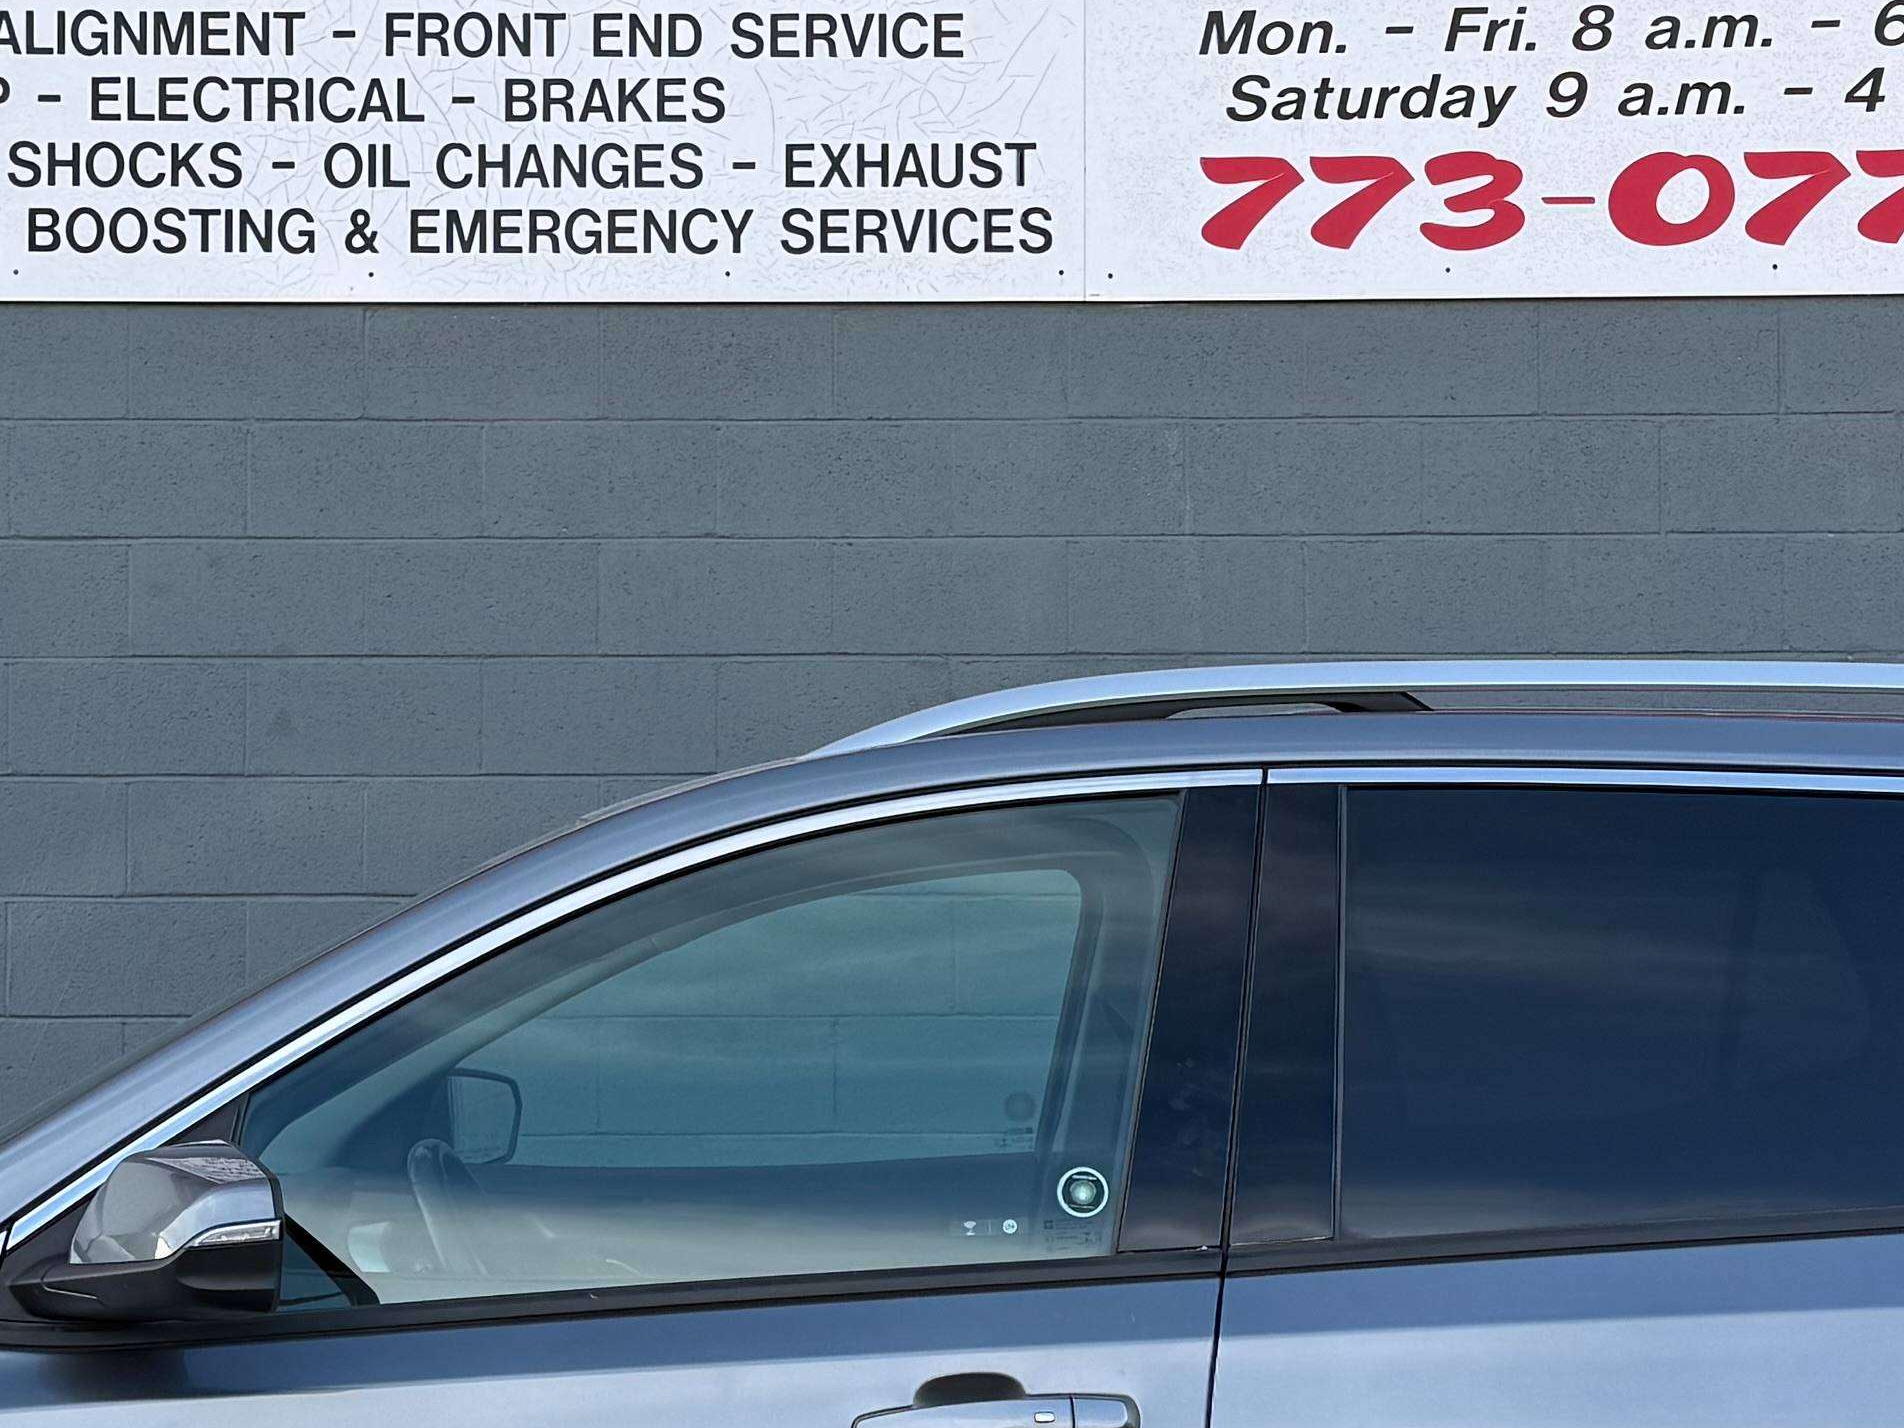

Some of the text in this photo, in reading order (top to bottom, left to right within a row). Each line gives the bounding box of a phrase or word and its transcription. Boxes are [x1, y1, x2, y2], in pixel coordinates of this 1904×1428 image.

[386, 12, 566, 57] FRONT
[594, 13, 702, 57] END
[731, 12, 963, 59] SERVICE
[1199, 10, 1346, 55] Mon.
[1445, 7, 1536, 51] Fri.
[1572, 5, 1614, 51] 8
[1645, 15, 1772, 49] a.m.
[92, 76, 424, 123] ELECTRICAL
[505, 77, 725, 123] BRAKES
[1227, 74, 1516, 128] Saturday
[1547, 72, 1587, 117] 9
[1618, 82, 1744, 116] a.m.
[1845, 68, 1885, 112] 4
[8, 141, 242, 188] SHOCKS
[324, 143, 410, 188] OIL
[437, 143, 703, 189] CHANGES
[786, 142, 1036, 188] EXHAUST
[29, 207, 314, 254] BOOSTING
[345, 209, 378, 254] &
[411, 208, 753, 254] EMERGENCY
[781, 207, 1052, 254] SERVICES
